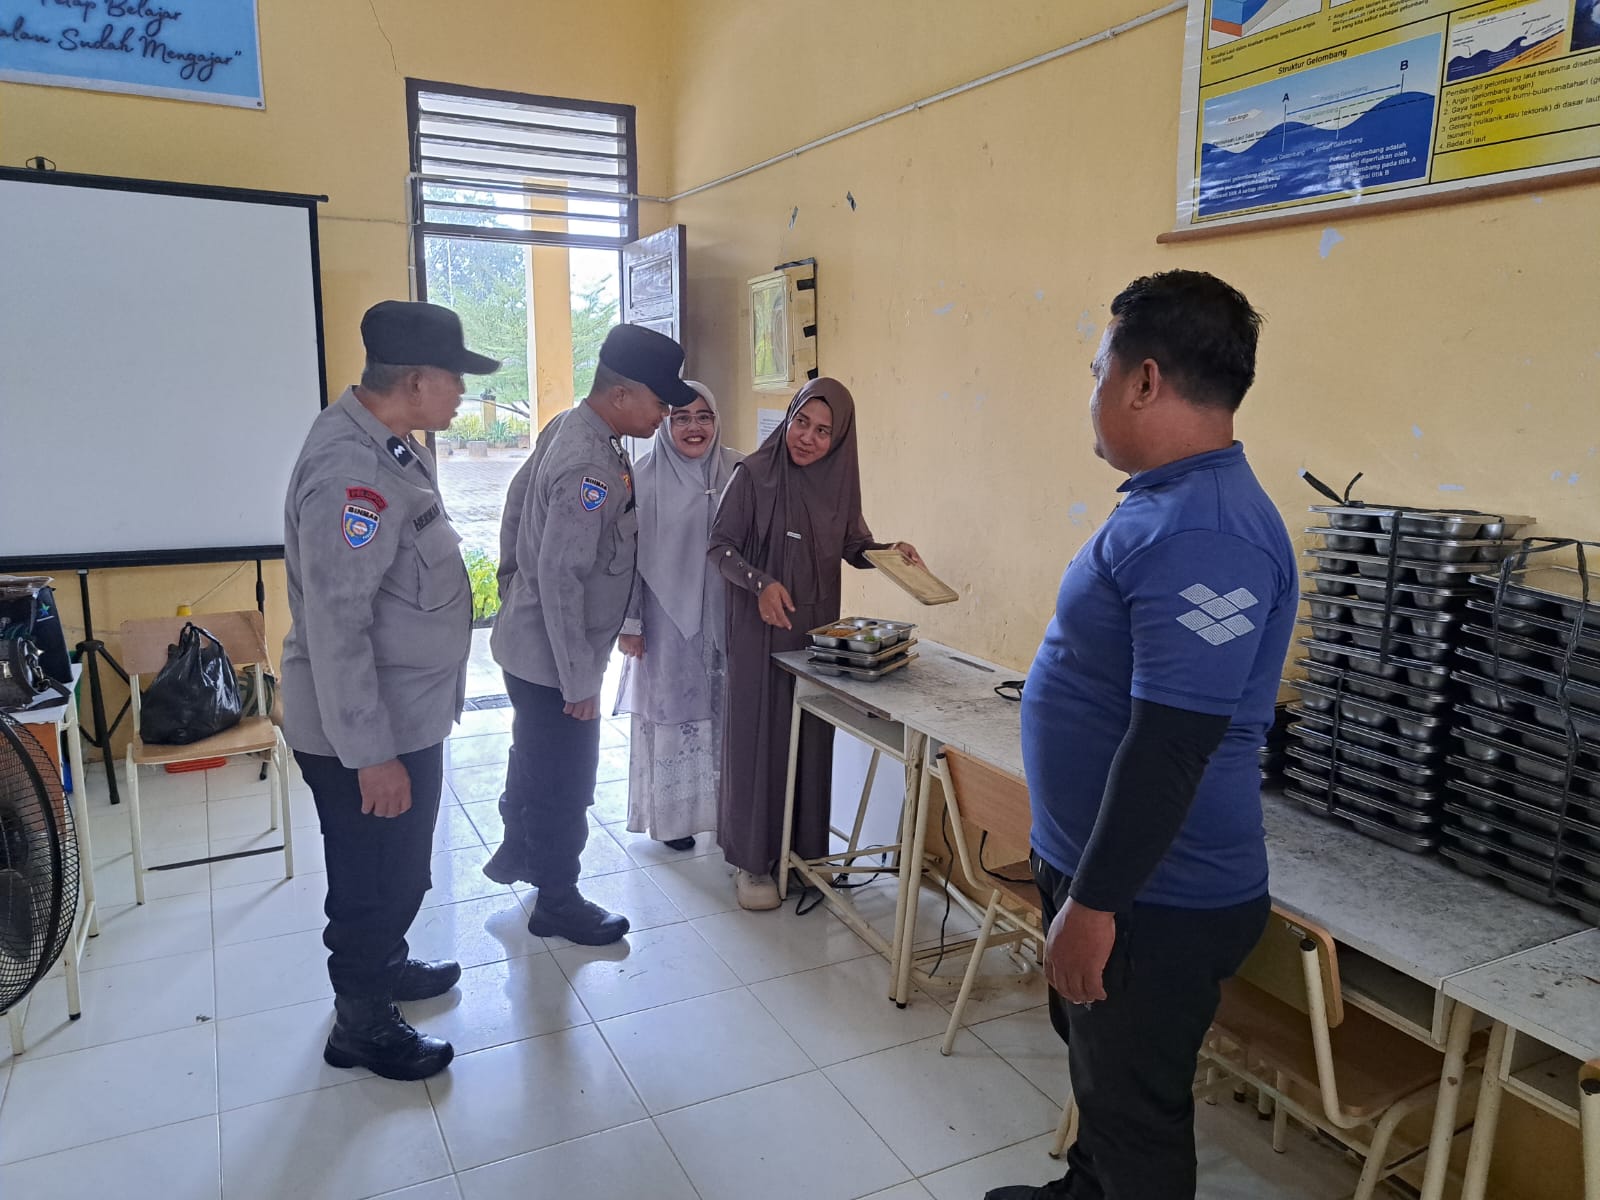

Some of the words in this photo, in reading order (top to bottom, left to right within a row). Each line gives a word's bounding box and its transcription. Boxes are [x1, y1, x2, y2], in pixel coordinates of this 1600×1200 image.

[104, 0, 182, 37] Belajar
[58, 24, 135, 53] Sudah
[1278, 60, 1305, 75] Struktur
[1306, 48, 1348, 68] Gelombang
[1400, 59, 1409, 71] B
[1484, 75, 1522, 90] gelombang
[1523, 71, 1537, 80] laut
[1538, 63, 1571, 77] terutama
[1281, 93, 1290, 103] A
[1451, 96, 1470, 106] Angin
[1471, 87, 1510, 103] (gelombang
[1511, 81, 1534, 94] angin)
[1449, 121, 1472, 132] Gempa
[1504, 111, 1520, 120] atau
[1521, 104, 1552, 118] tektonik)
[1553, 102, 1561, 110] di
[1562, 98, 1584, 109] dasar
[1451, 105, 1469, 115] Gaya
[1447, 128, 1474, 140] tsunami)
[1446, 139, 1465, 149] Badai
[1473, 135, 1487, 145] laut
[1350, 146, 1384, 160] Gelombang
[1385, 141, 1407, 152] adalah
[1393, 150, 1408, 159] oleh
[1381, 160, 1398, 170] pada
[1398, 157, 1411, 166] titik
[1371, 171, 1383, 179] titik
[347, 506, 379, 522] BINMAS
